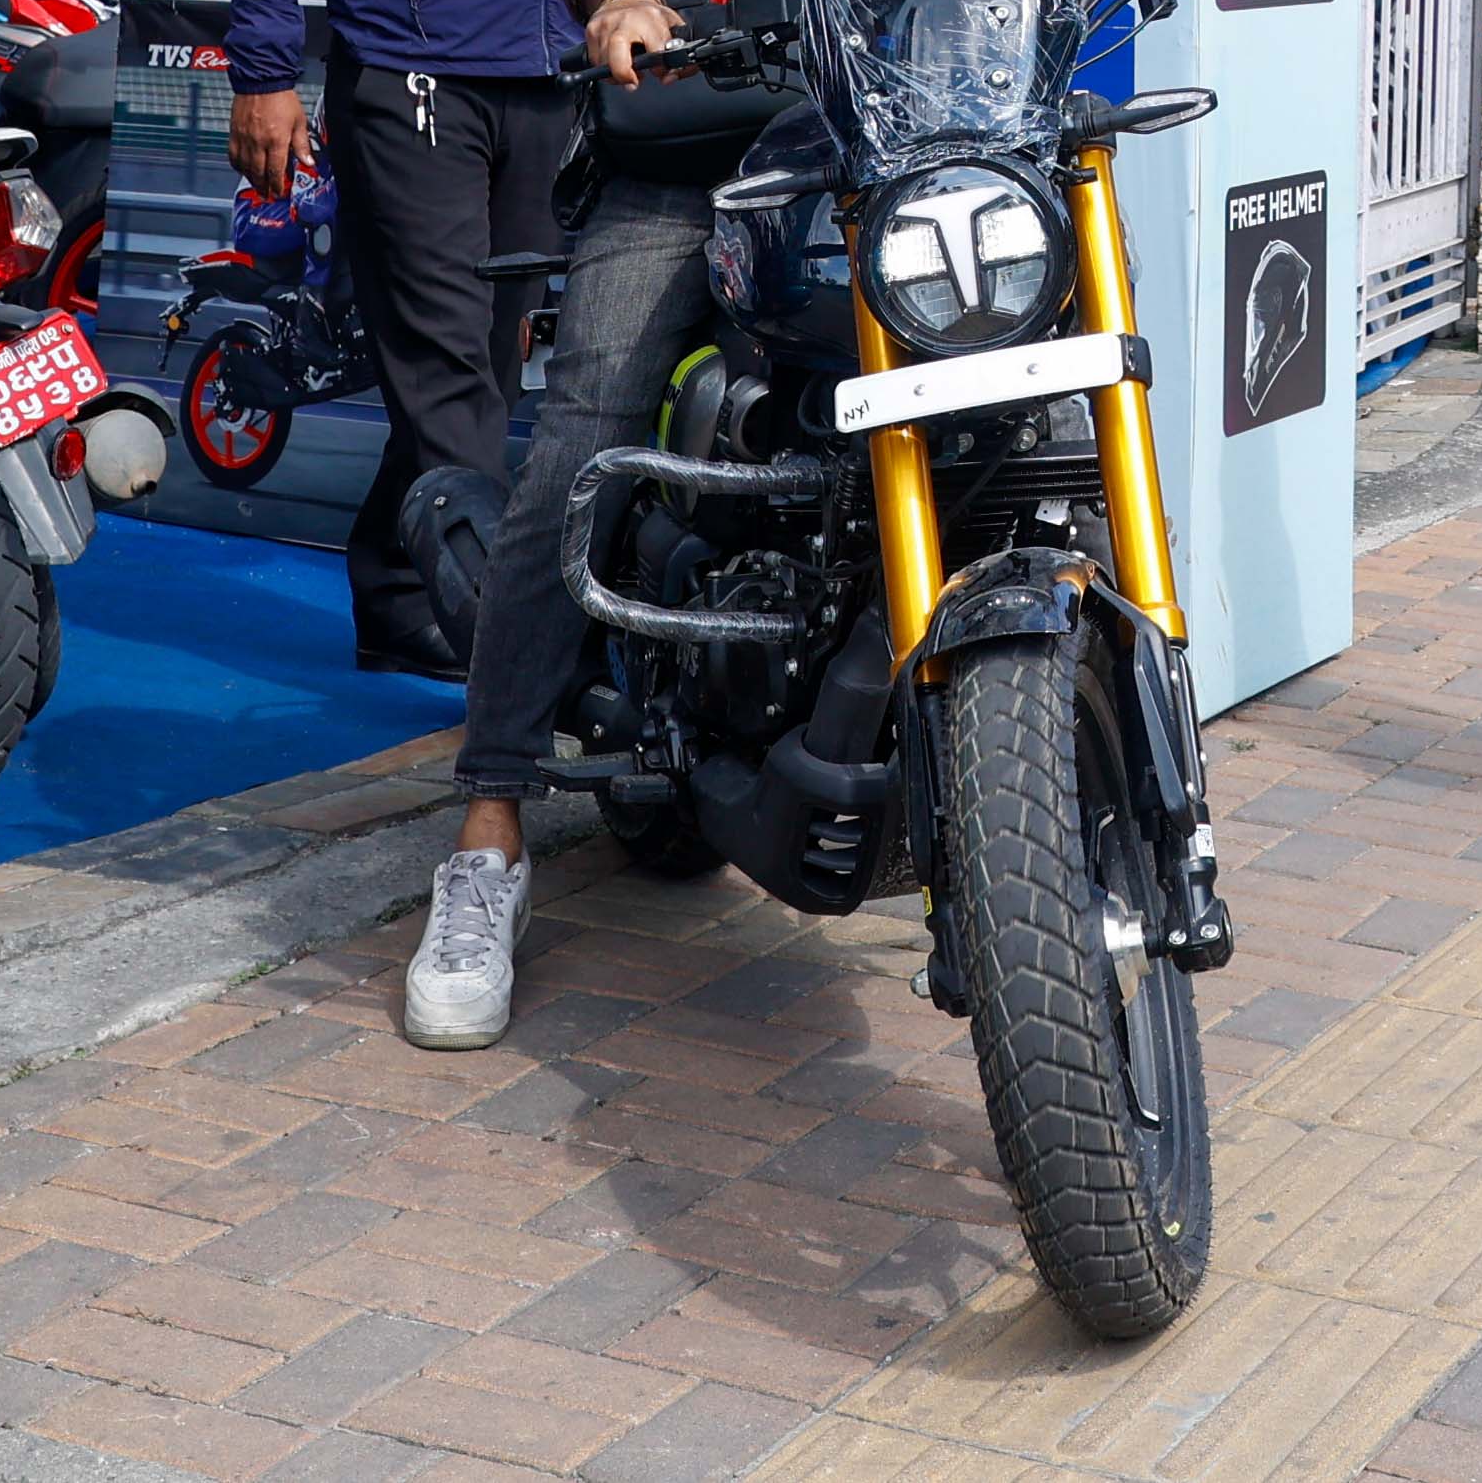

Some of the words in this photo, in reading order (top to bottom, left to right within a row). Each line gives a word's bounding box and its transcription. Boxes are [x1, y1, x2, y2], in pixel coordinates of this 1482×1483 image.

[148, 44, 193, 68] TVS
[1229, 191, 1267, 232] FREE
[1268, 180, 1326, 223] HELMET
